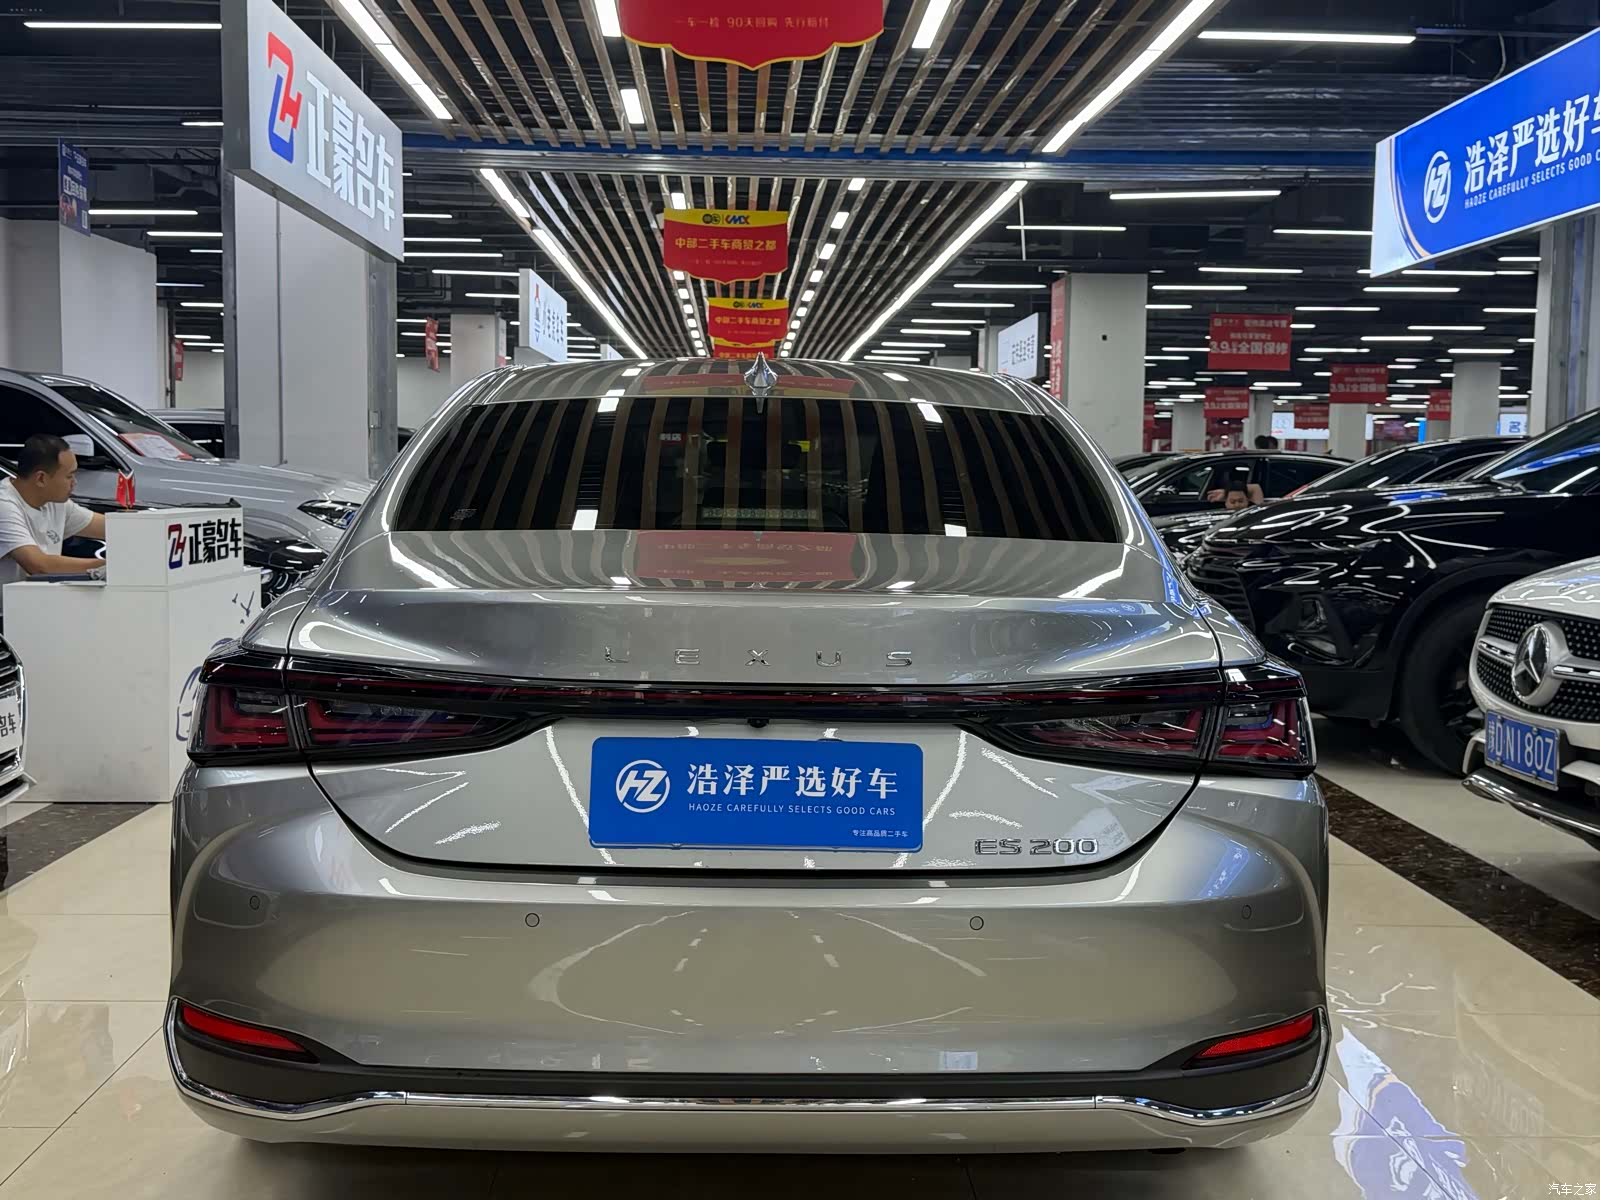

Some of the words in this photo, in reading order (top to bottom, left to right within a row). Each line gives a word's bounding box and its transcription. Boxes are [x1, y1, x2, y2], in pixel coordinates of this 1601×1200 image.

[727, 16, 778, 28] 90天回购
[305, 70, 396, 231] 正豪名车
[1464, 192, 1487, 209] HAOZE
[1488, 176, 1529, 201] CAREFULLY
[1531, 162, 1565, 184] SELECTS
[1568, 152, 1592, 171] GOOD
[675, 237, 777, 251] 中部二手车商贸之都
[188, 518, 242, 565] 正豪名车
[604, 647, 913, 668] LEXUS
[687, 763, 899, 800] 浩泽严选好车
[688, 803, 723, 812] HAOZE
[726, 804, 785, 813] CAREFULLY
[788, 805, 832, 814] SELECTS
[836, 806, 866, 815] GOOD
[869, 807, 896, 816] CARS
[974, 838, 1022, 855] ES
[1029, 838, 1098, 855] 200
